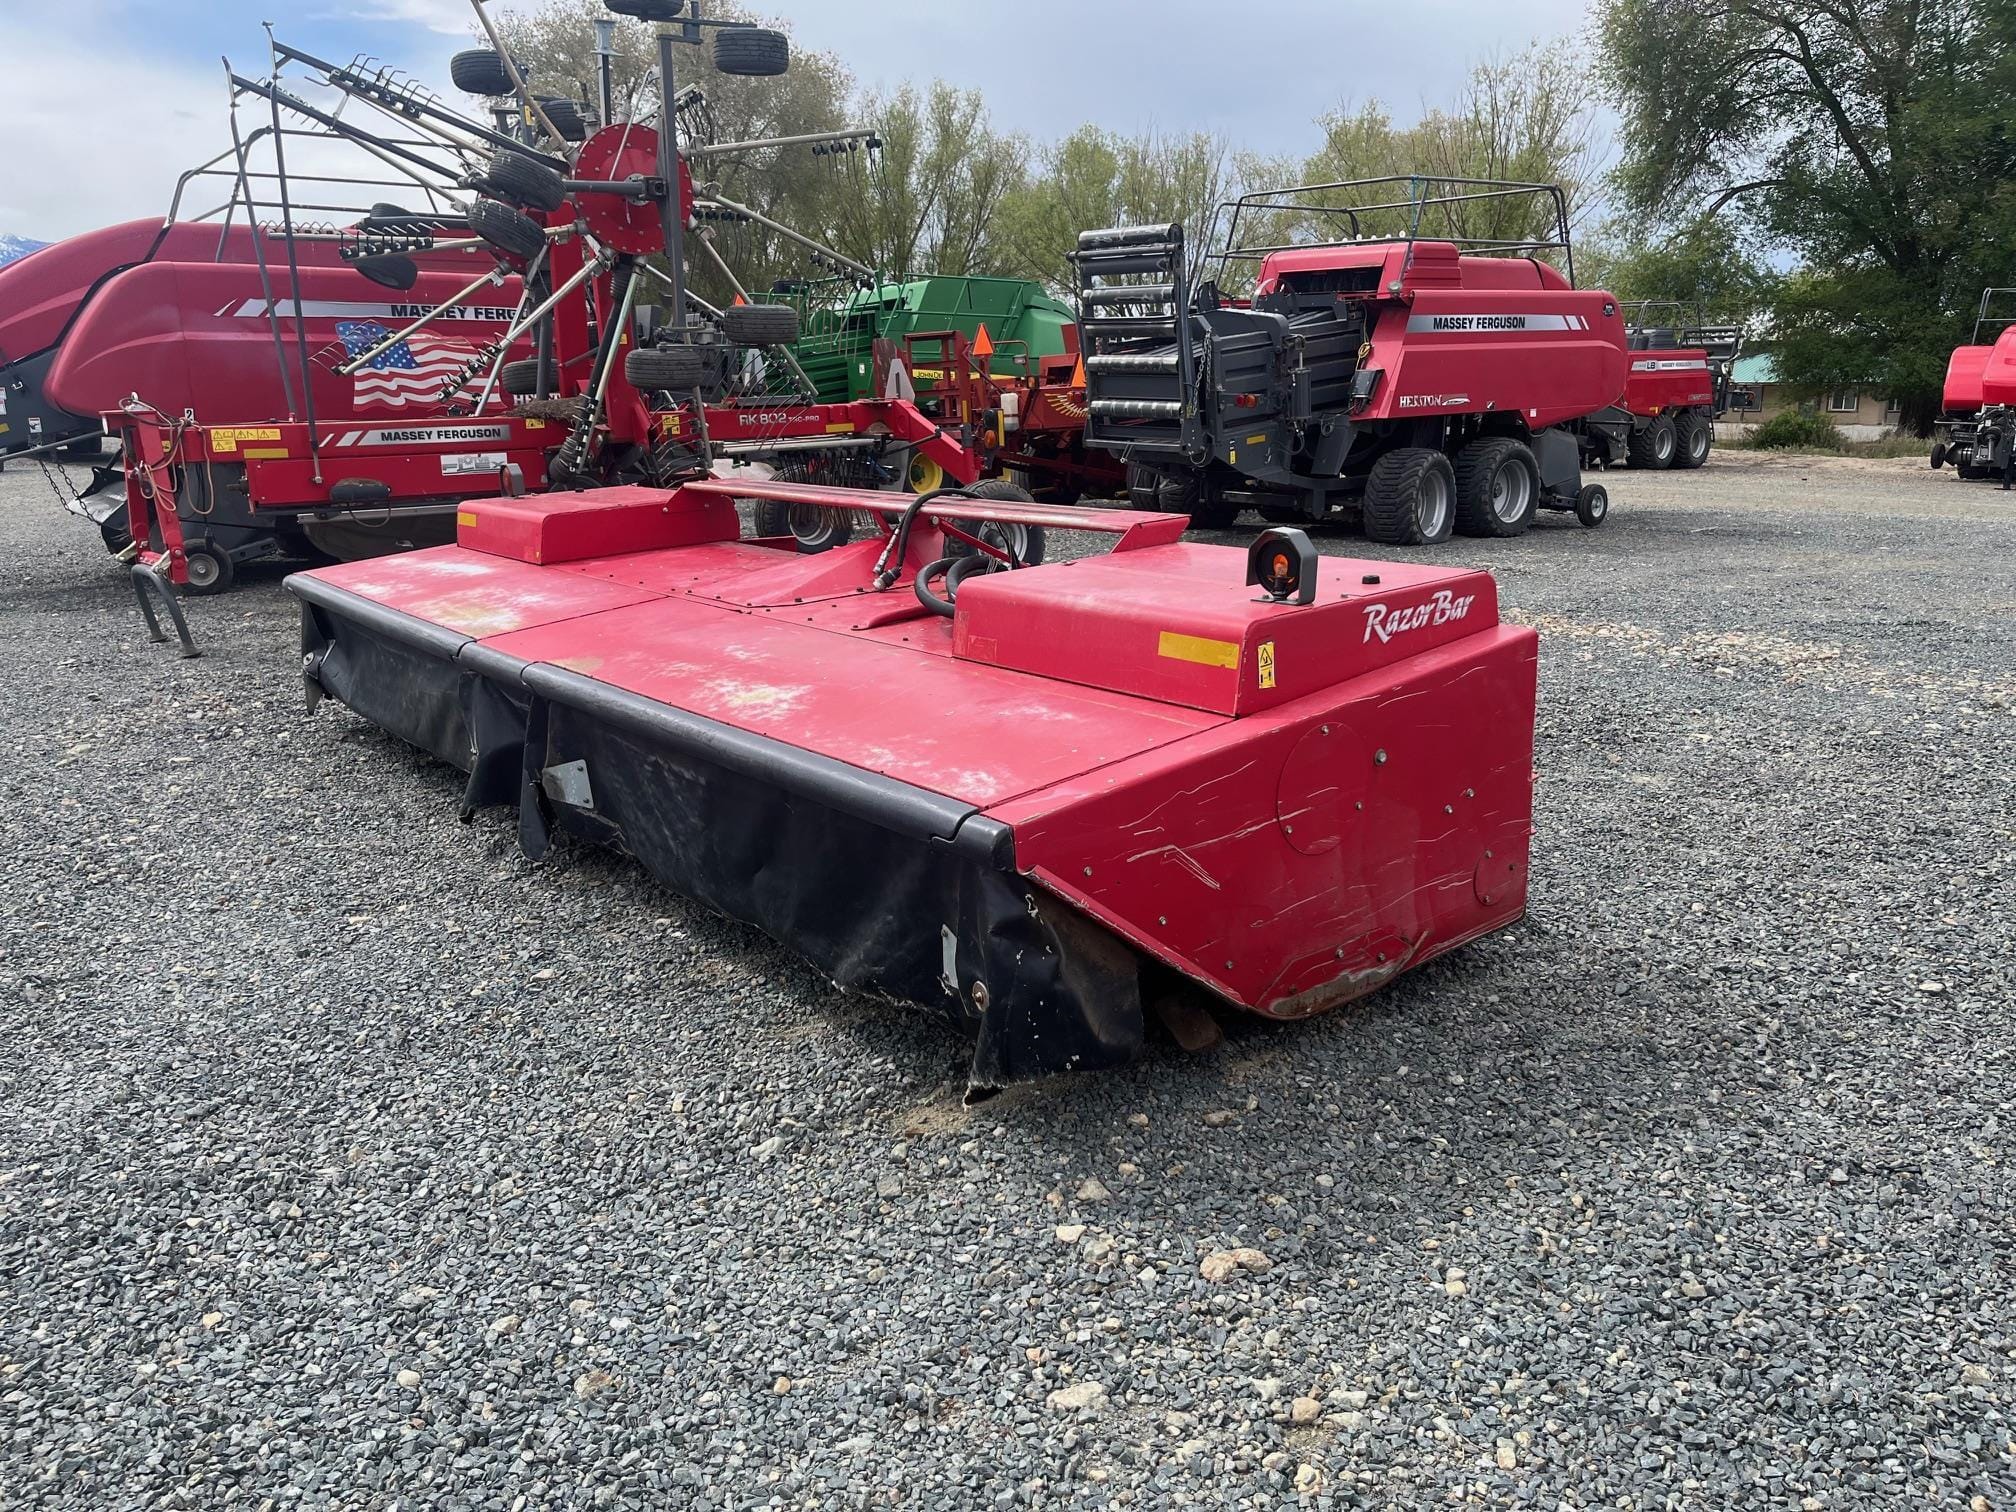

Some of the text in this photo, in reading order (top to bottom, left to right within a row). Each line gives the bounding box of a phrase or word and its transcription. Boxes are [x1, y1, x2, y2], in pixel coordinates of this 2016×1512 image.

[391, 304, 467, 319] MASEY
[1433, 317, 1525, 329] MASSEY FERGUSON
[739, 414, 758, 426] RK
[759, 413, 787, 425] 802
[380, 428, 500, 441] MASSEY FERGUSON
[1362, 590, 1475, 644] RazorBar
